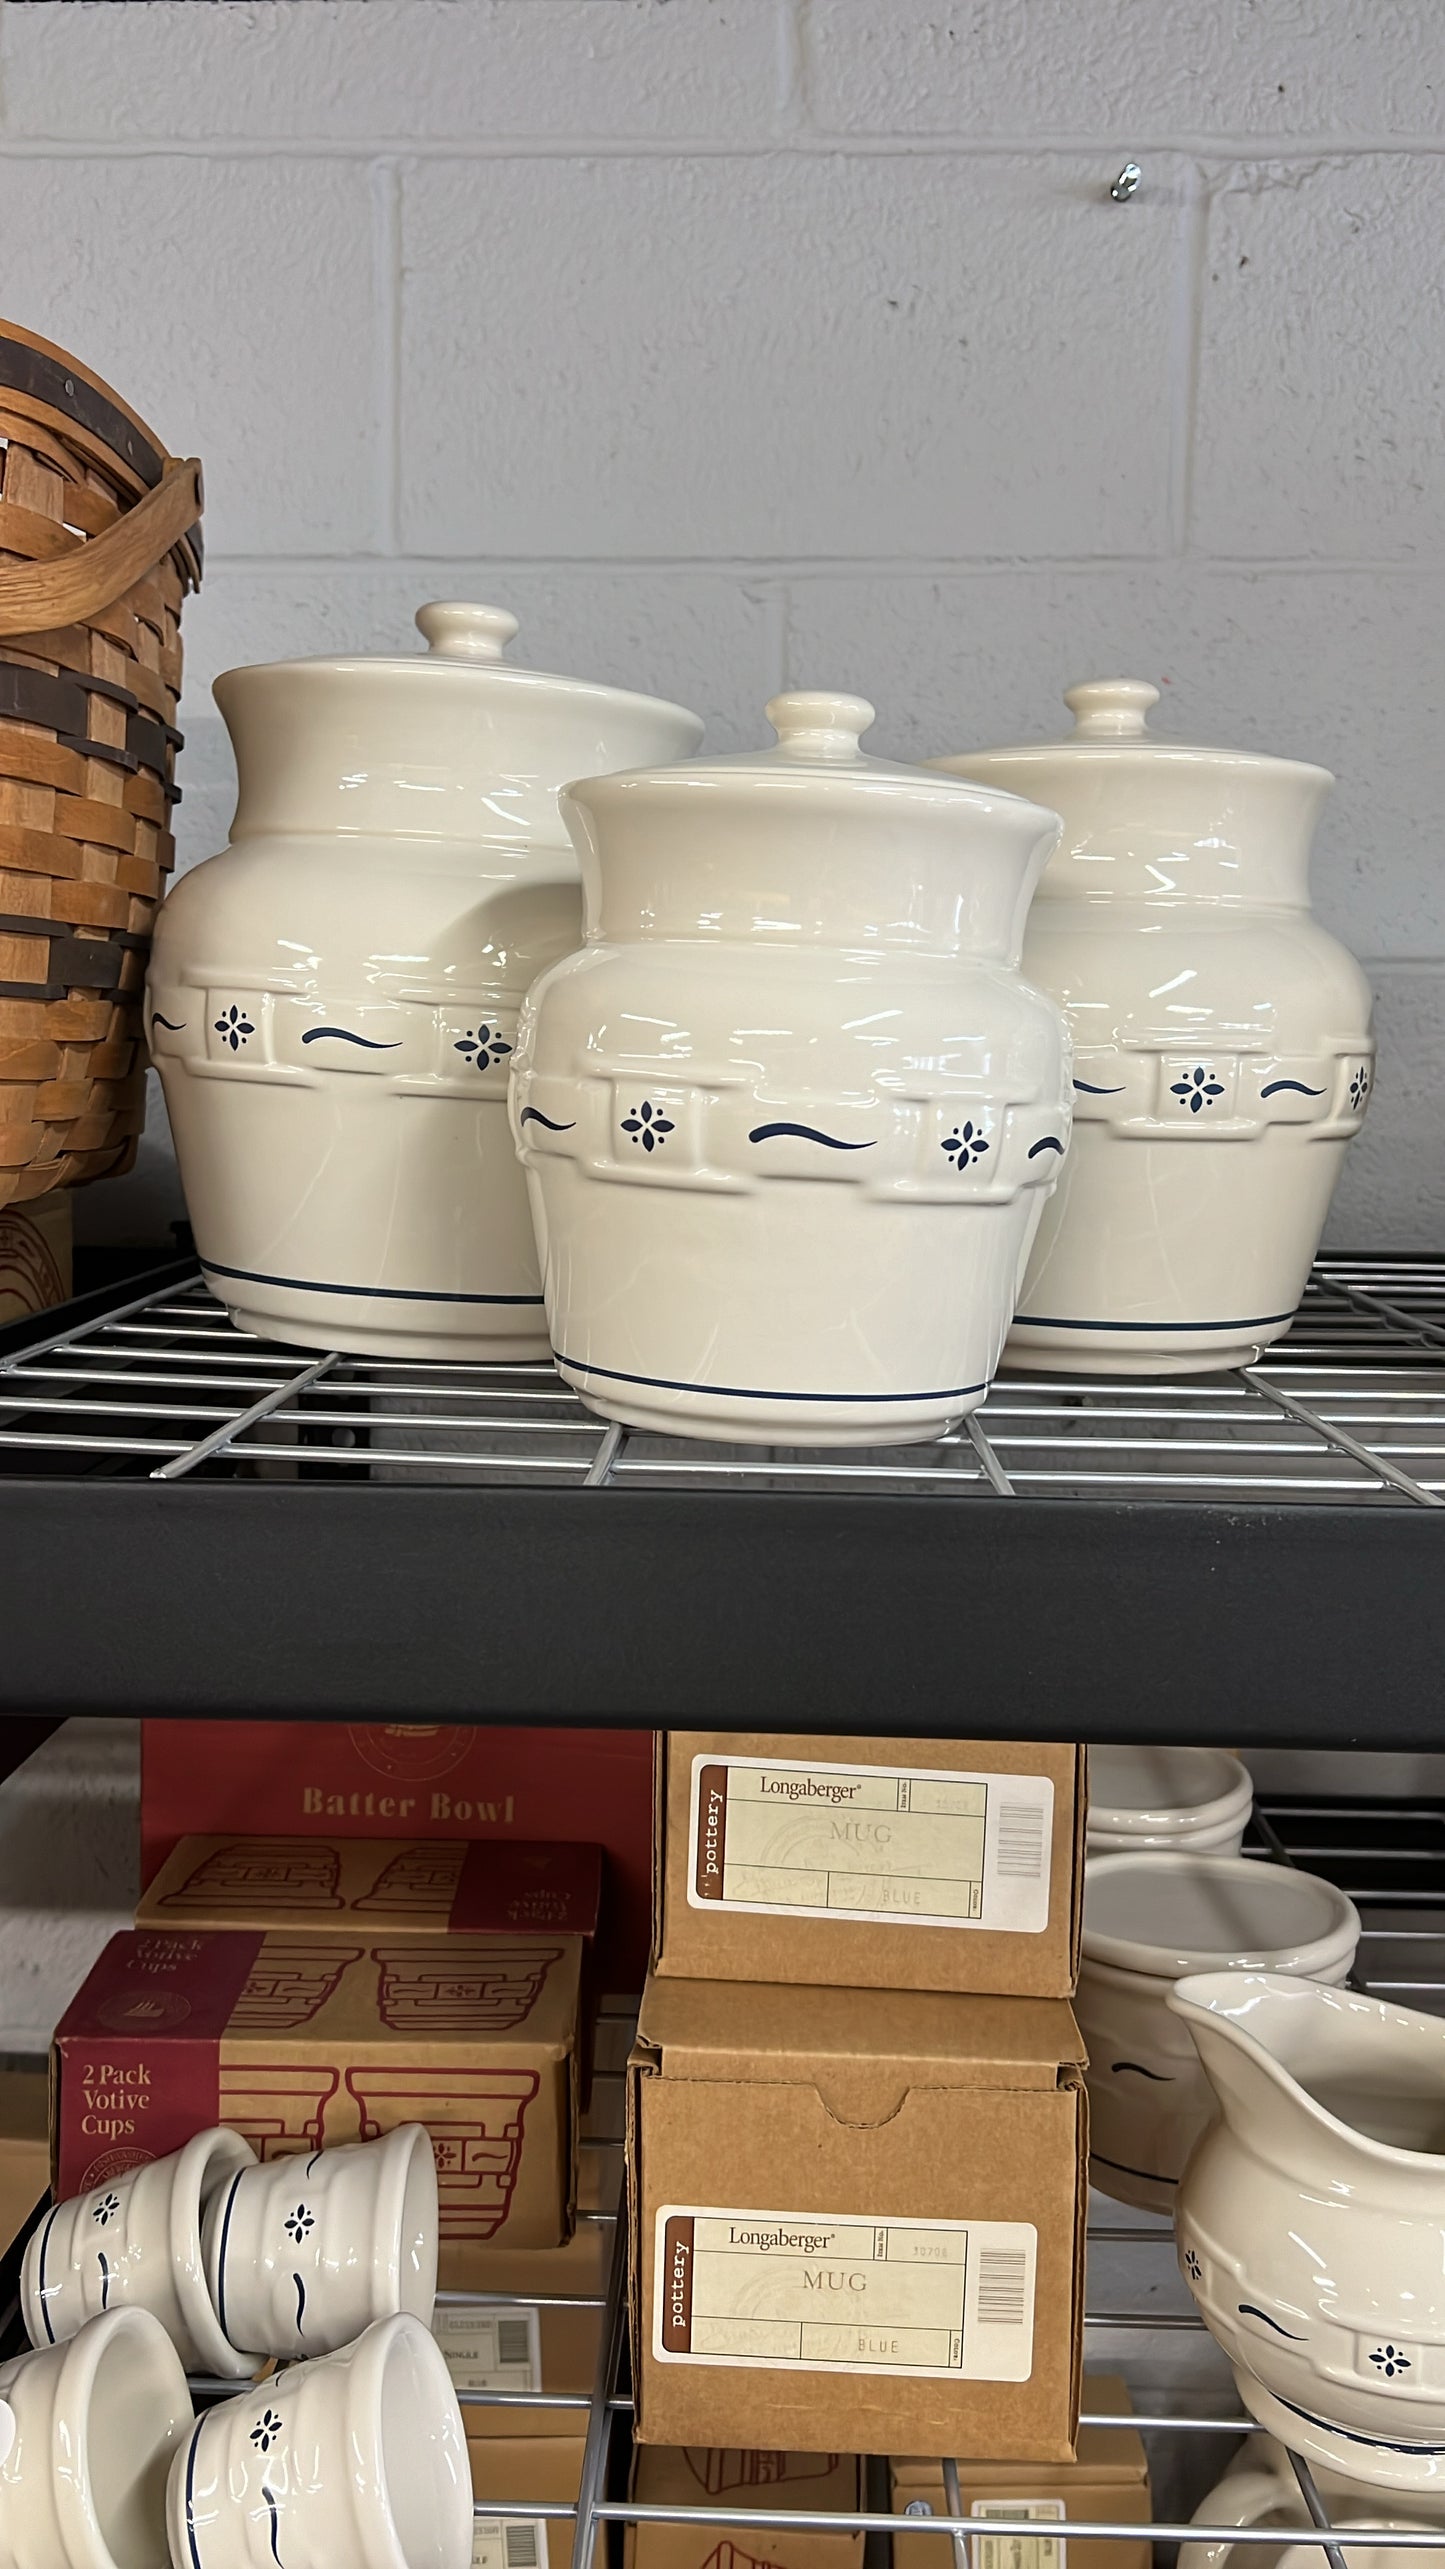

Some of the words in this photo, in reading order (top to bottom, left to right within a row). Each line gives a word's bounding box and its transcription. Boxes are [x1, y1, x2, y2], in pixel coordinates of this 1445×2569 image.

[303, 1787, 416, 1817] Batter
[431, 1793, 515, 1823] Bowl
[706, 1790, 724, 1875] pottery
[830, 1821, 893, 1843] MUG
[882, 1889, 921, 1905] BLUE
[82, 2064, 95, 2085] 2
[99, 2063, 151, 2085] Pack
[83, 2089, 150, 2110] Votive
[81, 2114, 135, 2141] Cups
[671, 2241, 689, 2327] pottery
[803, 2270, 868, 2292] MUG
[858, 2338, 899, 2354] BLUE
